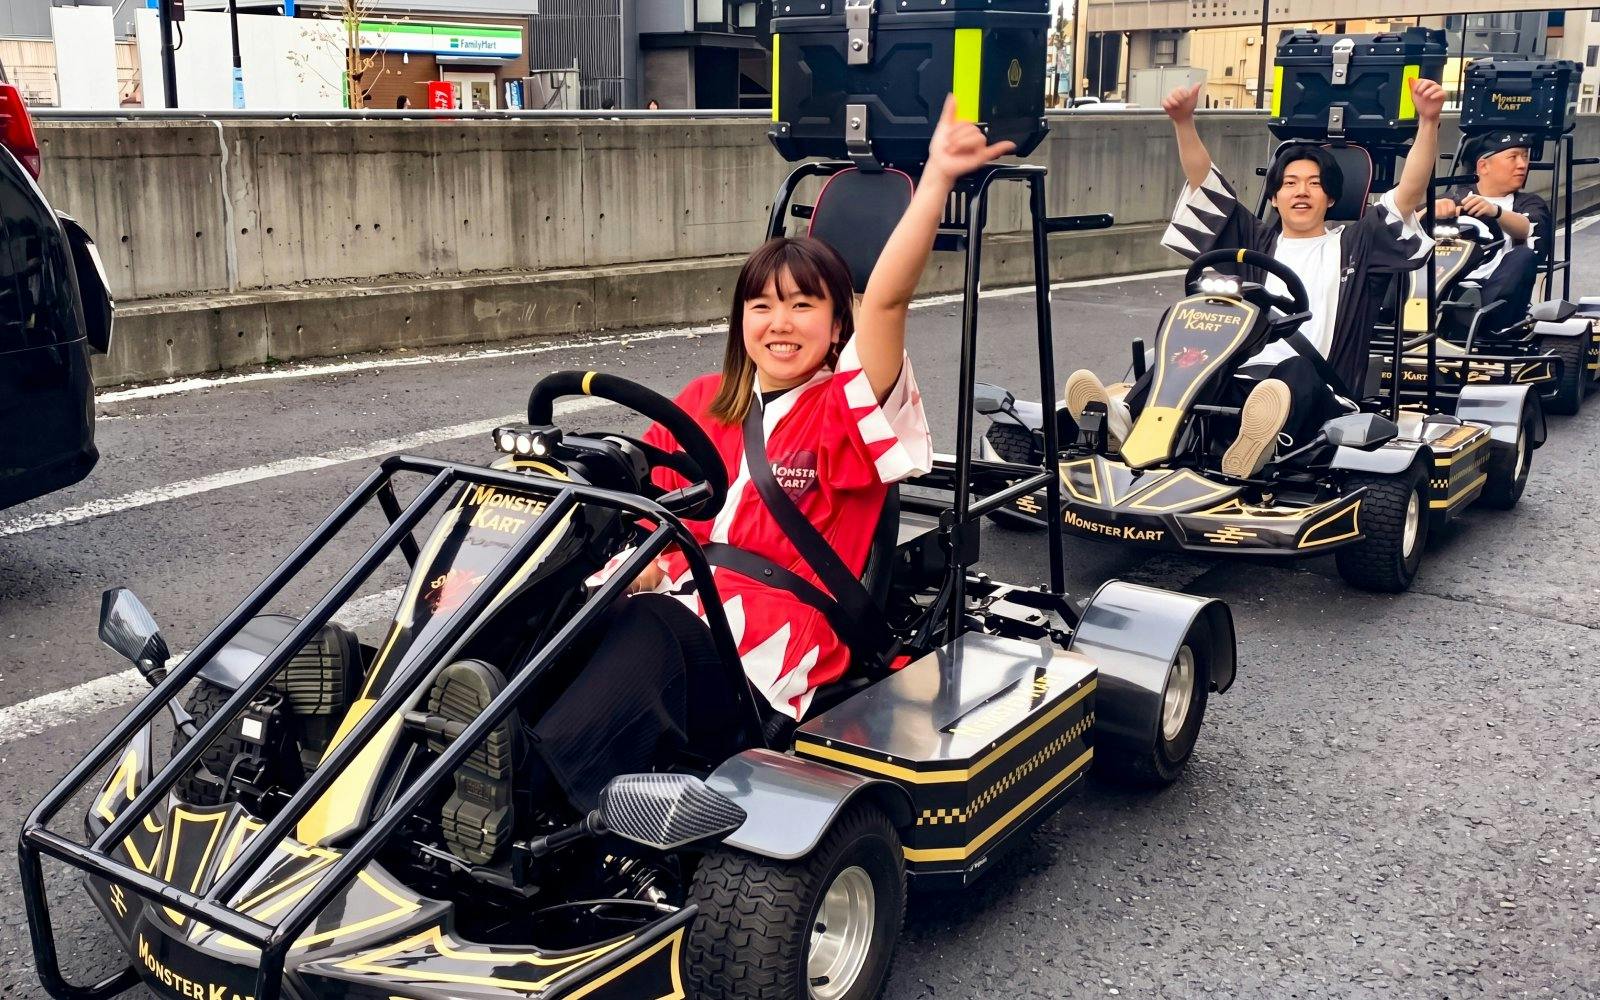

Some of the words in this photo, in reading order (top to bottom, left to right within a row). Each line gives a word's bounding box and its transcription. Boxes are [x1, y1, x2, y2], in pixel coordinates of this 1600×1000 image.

[460, 39, 497, 51] FamilyMart
[1178, 308, 1241, 325] MONSTER
[1184, 319, 1222, 332] KART
[468, 485, 547, 516] MONSTE
[469, 505, 526, 534] KART
[1064, 510, 1121, 537] MONSTER
[1123, 526, 1164, 541] KART
[138, 932, 204, 1000] MONSTER
